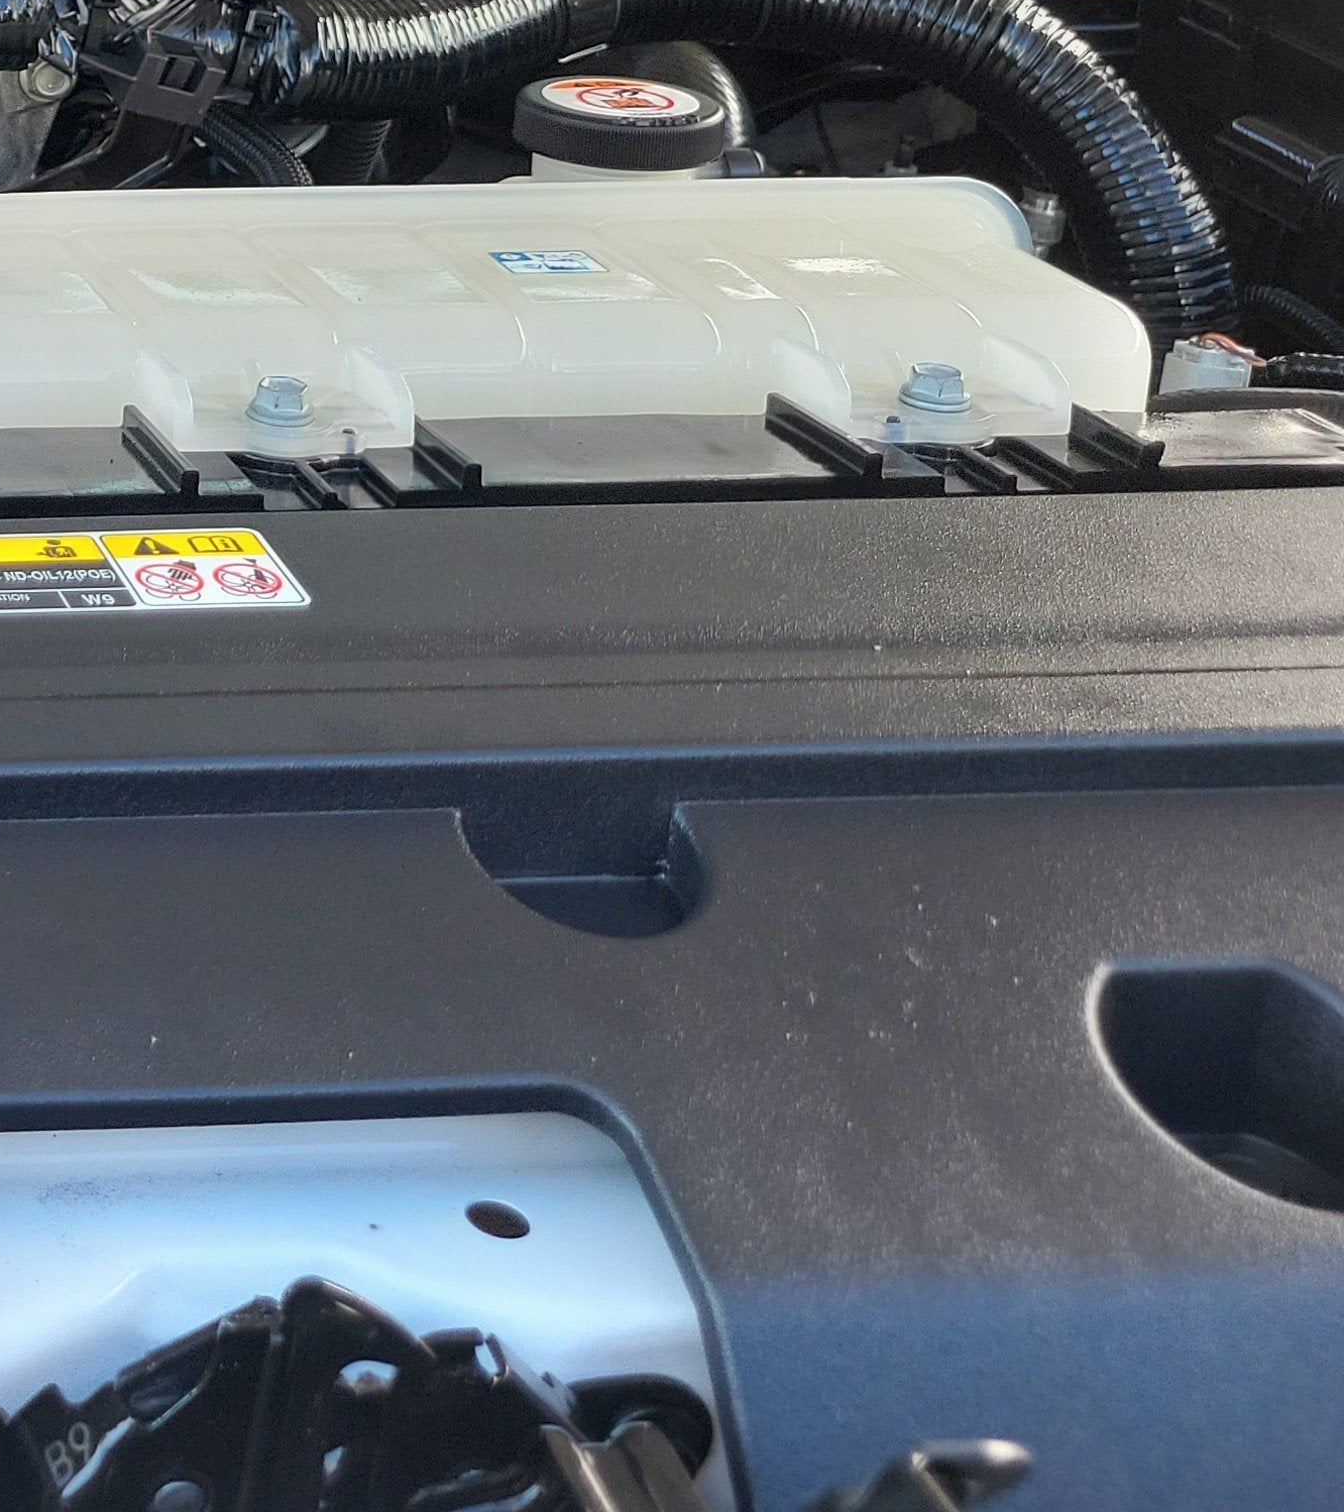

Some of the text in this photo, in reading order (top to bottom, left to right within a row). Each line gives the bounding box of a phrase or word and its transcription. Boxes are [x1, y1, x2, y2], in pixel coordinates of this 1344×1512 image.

[3, 568, 116, 583] ND-OIL12(POE)
[81, 593, 115, 606] W9
[45, 1421, 91, 1487] B9
